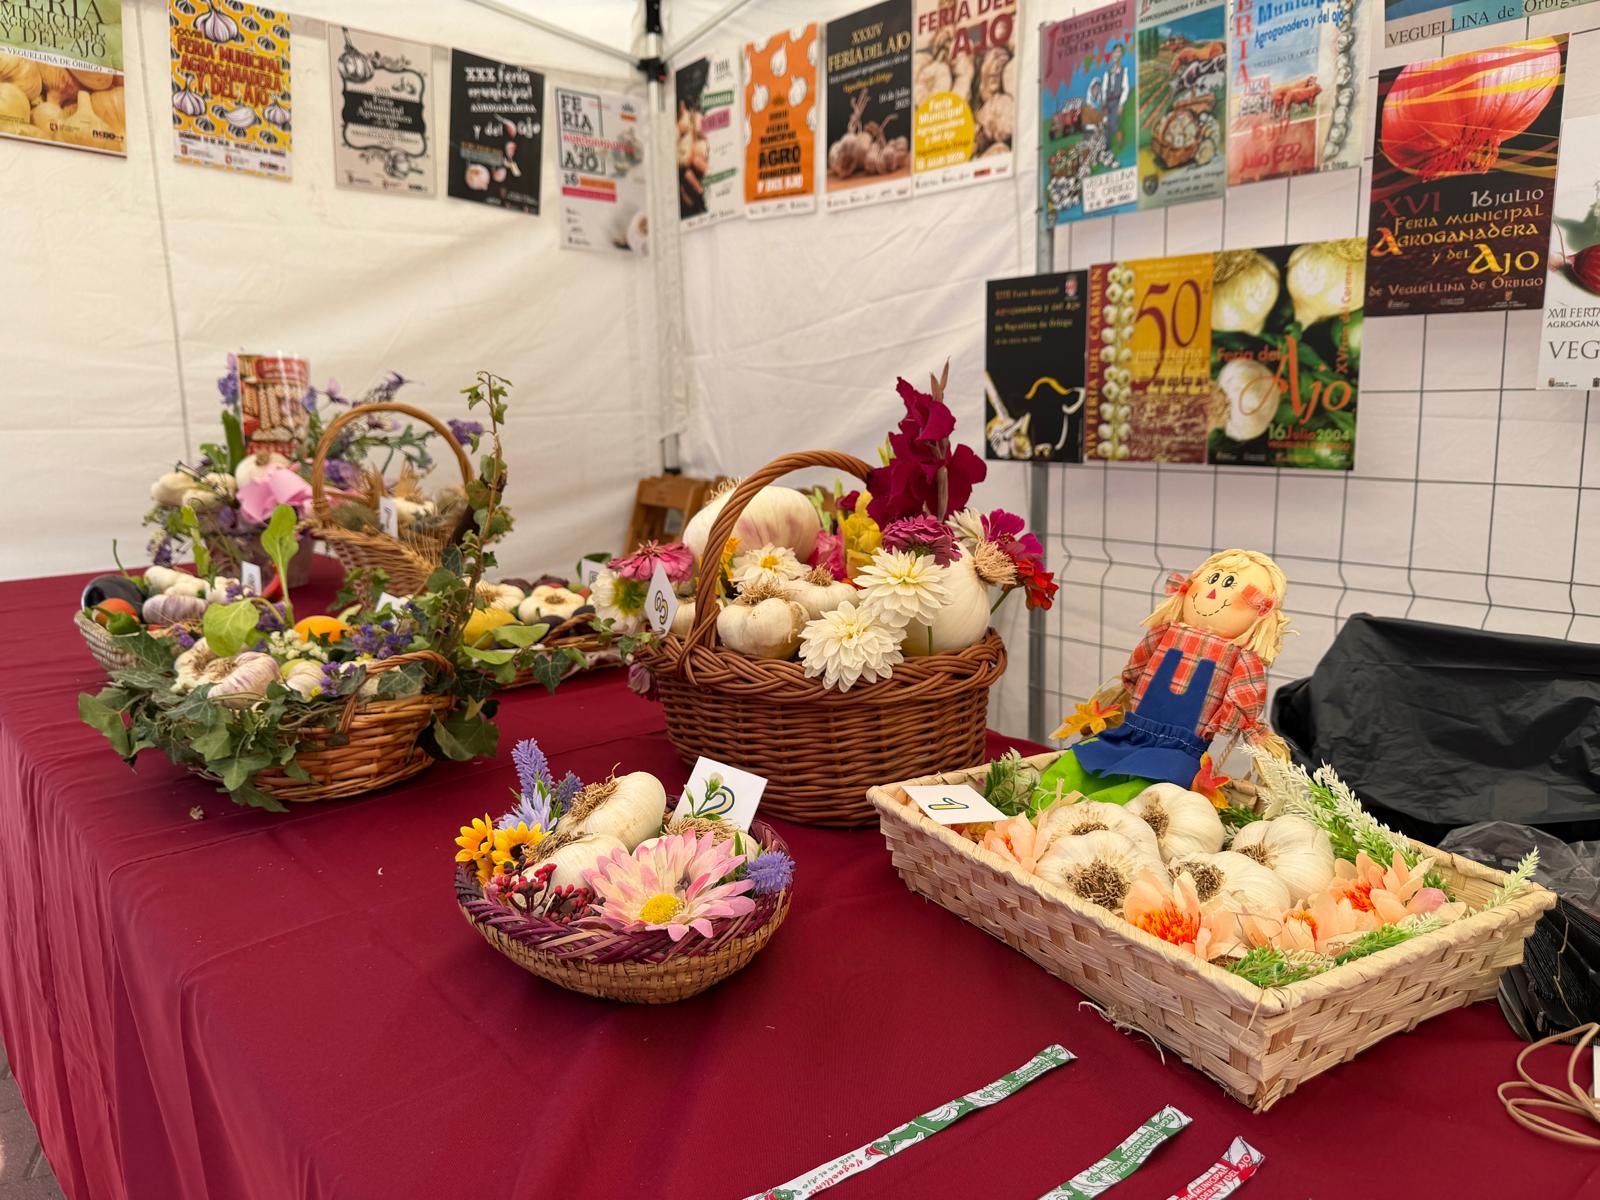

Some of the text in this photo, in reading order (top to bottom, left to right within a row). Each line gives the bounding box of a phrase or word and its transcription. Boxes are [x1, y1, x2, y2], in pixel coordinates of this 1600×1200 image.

[918, 1, 970, 36] FERIA
[1317, 8, 1330, 24] del
[1388, 14, 1490, 45] VEGUELLINA
[1497, 5, 1516, 20] de
[0, 22, 106, 58] Y DEL AJO
[177, 36, 215, 60] FERIA
[952, 14, 1013, 60] AJO
[7, 47, 57, 63] VEGUELLINA
[59, 58, 71, 67] DE
[219, 45, 283, 75] MUNICIPAL
[828, 48, 863, 73] FERIA
[886, 30, 912, 53] AJO
[464, 66, 497, 83] XXX
[211, 74, 238, 100] DEL
[243, 82, 270, 109] AJO
[561, 94, 583, 113] FE
[561, 111, 594, 132] RIA
[564, 149, 600, 173] AJO
[759, 144, 802, 169] AGRO
[1381, 191, 1441, 218] XVI
[1470, 189, 1492, 209] 16
[1089, 267, 1102, 341] CARMEN
[1547, 308, 1567, 319] XVII
[1088, 347, 1100, 373] DEL
[1216, 347, 1255, 364] Feria
[1257, 343, 1283, 362] del
[1548, 340, 1600, 360] VEG
[1239, 335, 1352, 425] Ajo
[1087, 379, 1099, 424] FERIA
[1268, 423, 1350, 441] 16 Julio 2004
[655, 590, 669, 625] 3
[928, 797, 970, 811] 1
[1110, 1130, 1164, 1179] FERIA MUNICIPAL
[1223, 1169, 1240, 1181] DEL
[1238, 1154, 1251, 1169] AJO
[1193, 1167, 1229, 1195] MUNICIPAL
